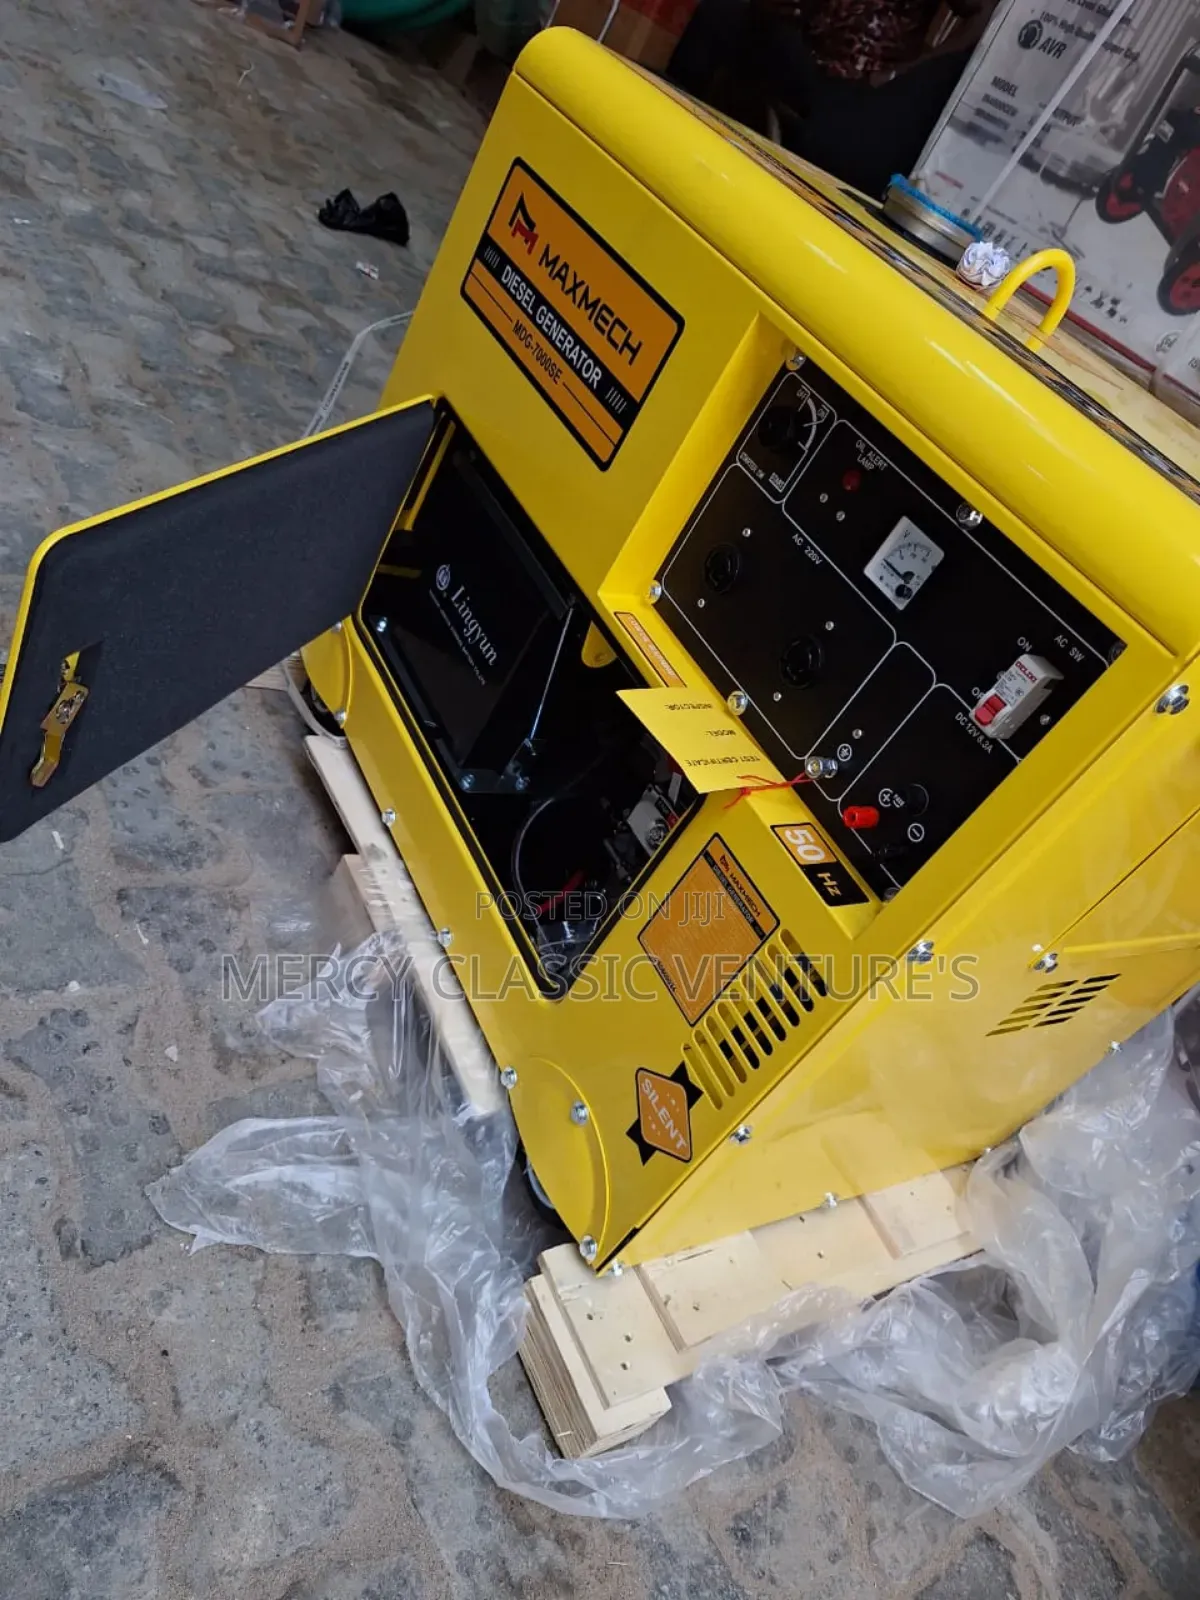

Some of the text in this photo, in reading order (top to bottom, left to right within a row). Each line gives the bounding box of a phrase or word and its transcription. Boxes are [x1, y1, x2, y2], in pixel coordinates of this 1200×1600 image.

[1038, 37, 1067, 59] AVR
[538, 243, 642, 366] MAXMECH
[501, 265, 602, 390] DIESEL GENERATOR
[512, 319, 563, 385] MDG-7000SE
[855, 439, 889, 471] OIL ALERT
[857, 455, 876, 472] LAMP
[792, 533, 823, 566] AC 220V
[450, 585, 499, 666] Lingyun
[1016, 636, 1033, 652] ON
[1054, 634, 1086, 663] AC SW
[954, 711, 969, 726] DC
[966, 723, 980, 741] 12V
[684, 754, 760, 767] TEST CERTIFICATE
[785, 829, 826, 862] 50
[730, 872, 761, 918] MAXMECH
[817, 872, 842, 897] Hz
[728, 884, 755, 924] GENERATOR
[641, 1078, 687, 1150] SILENT
